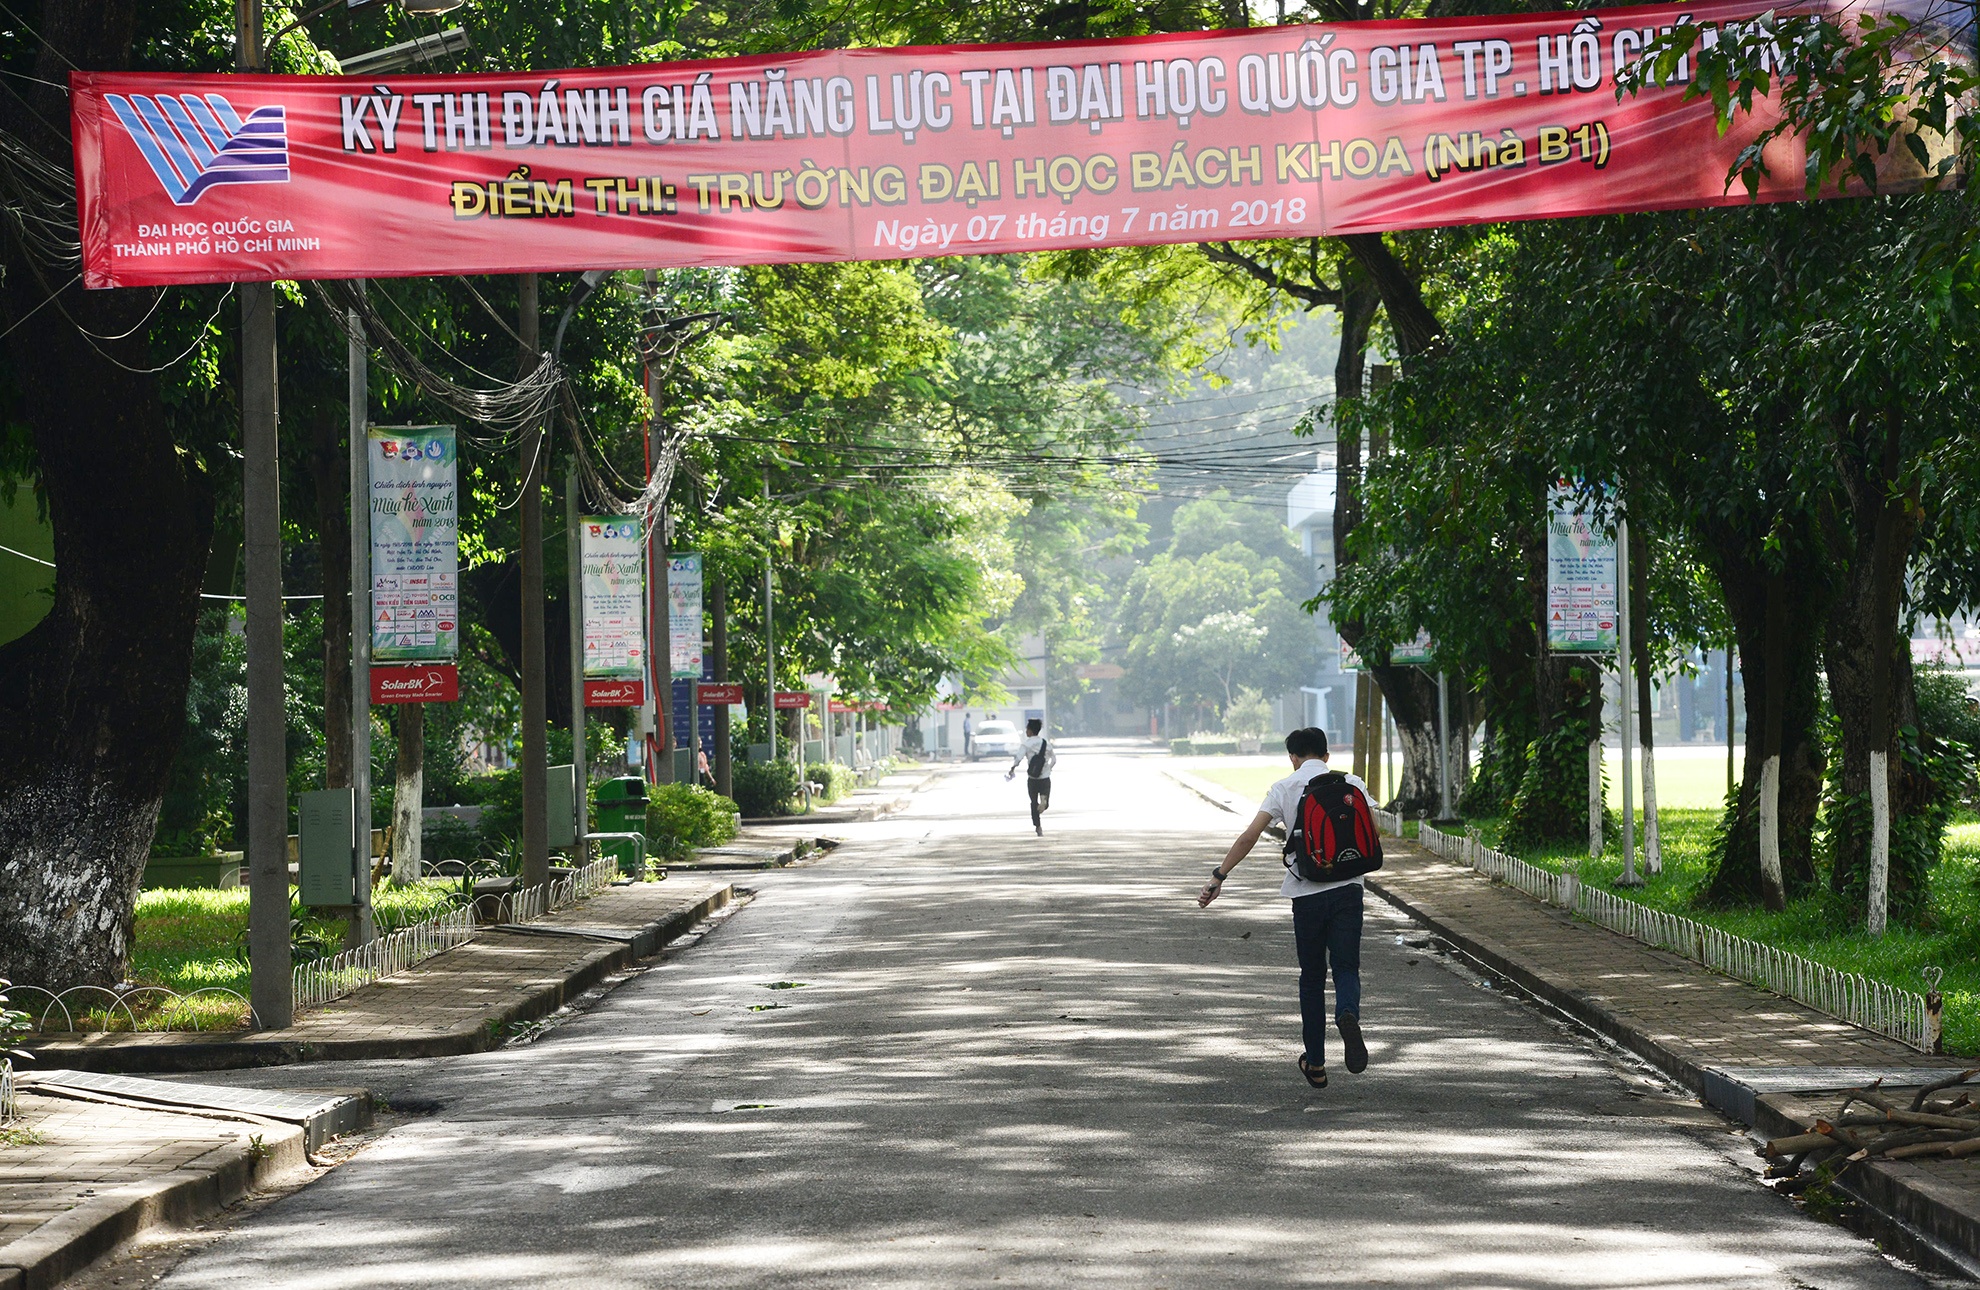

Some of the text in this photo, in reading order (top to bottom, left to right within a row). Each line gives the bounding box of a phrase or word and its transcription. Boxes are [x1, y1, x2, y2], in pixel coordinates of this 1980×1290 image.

[339, 85, 403, 151] KỲ
[412, 92, 491, 150] THI
[501, 79, 632, 147] ĐÁNH
[641, 73, 720, 142] GIÁ
[728, 69, 856, 138] NĂNG
[866, 70, 952, 141] LỰC
[961, 67, 1036, 136] TẠI
[1046, 63, 1123, 131] ĐẠI
[1134, 57, 1226, 126] HỌC
[1238, 33, 1358, 112] QUỐC
[1370, 43, 1446, 102] GIA
[1454, 39, 1527, 97] TP.
[1537, 15, 1603, 91] HỒ
[450, 121, 1610, 218] ĐIỂM THI: TRƯỜNG ĐẠI HỌC BÁCH KHOA (Nhà B1)
[137, 216, 295, 239] ĐẠI HỌC QUỐC GIA
[872, 196, 1307, 252] Ngày 07 tháng 7 năm 2018
[113, 235, 321, 258] THÀNH PHỐ HỒ CHÍ MINH
[372, 491, 455, 516] Mùa hè Xanh
[412, 516, 455, 529] năm 2018
[1550, 522, 1572, 537] Mùa
[380, 678, 424, 690] SolarBK
